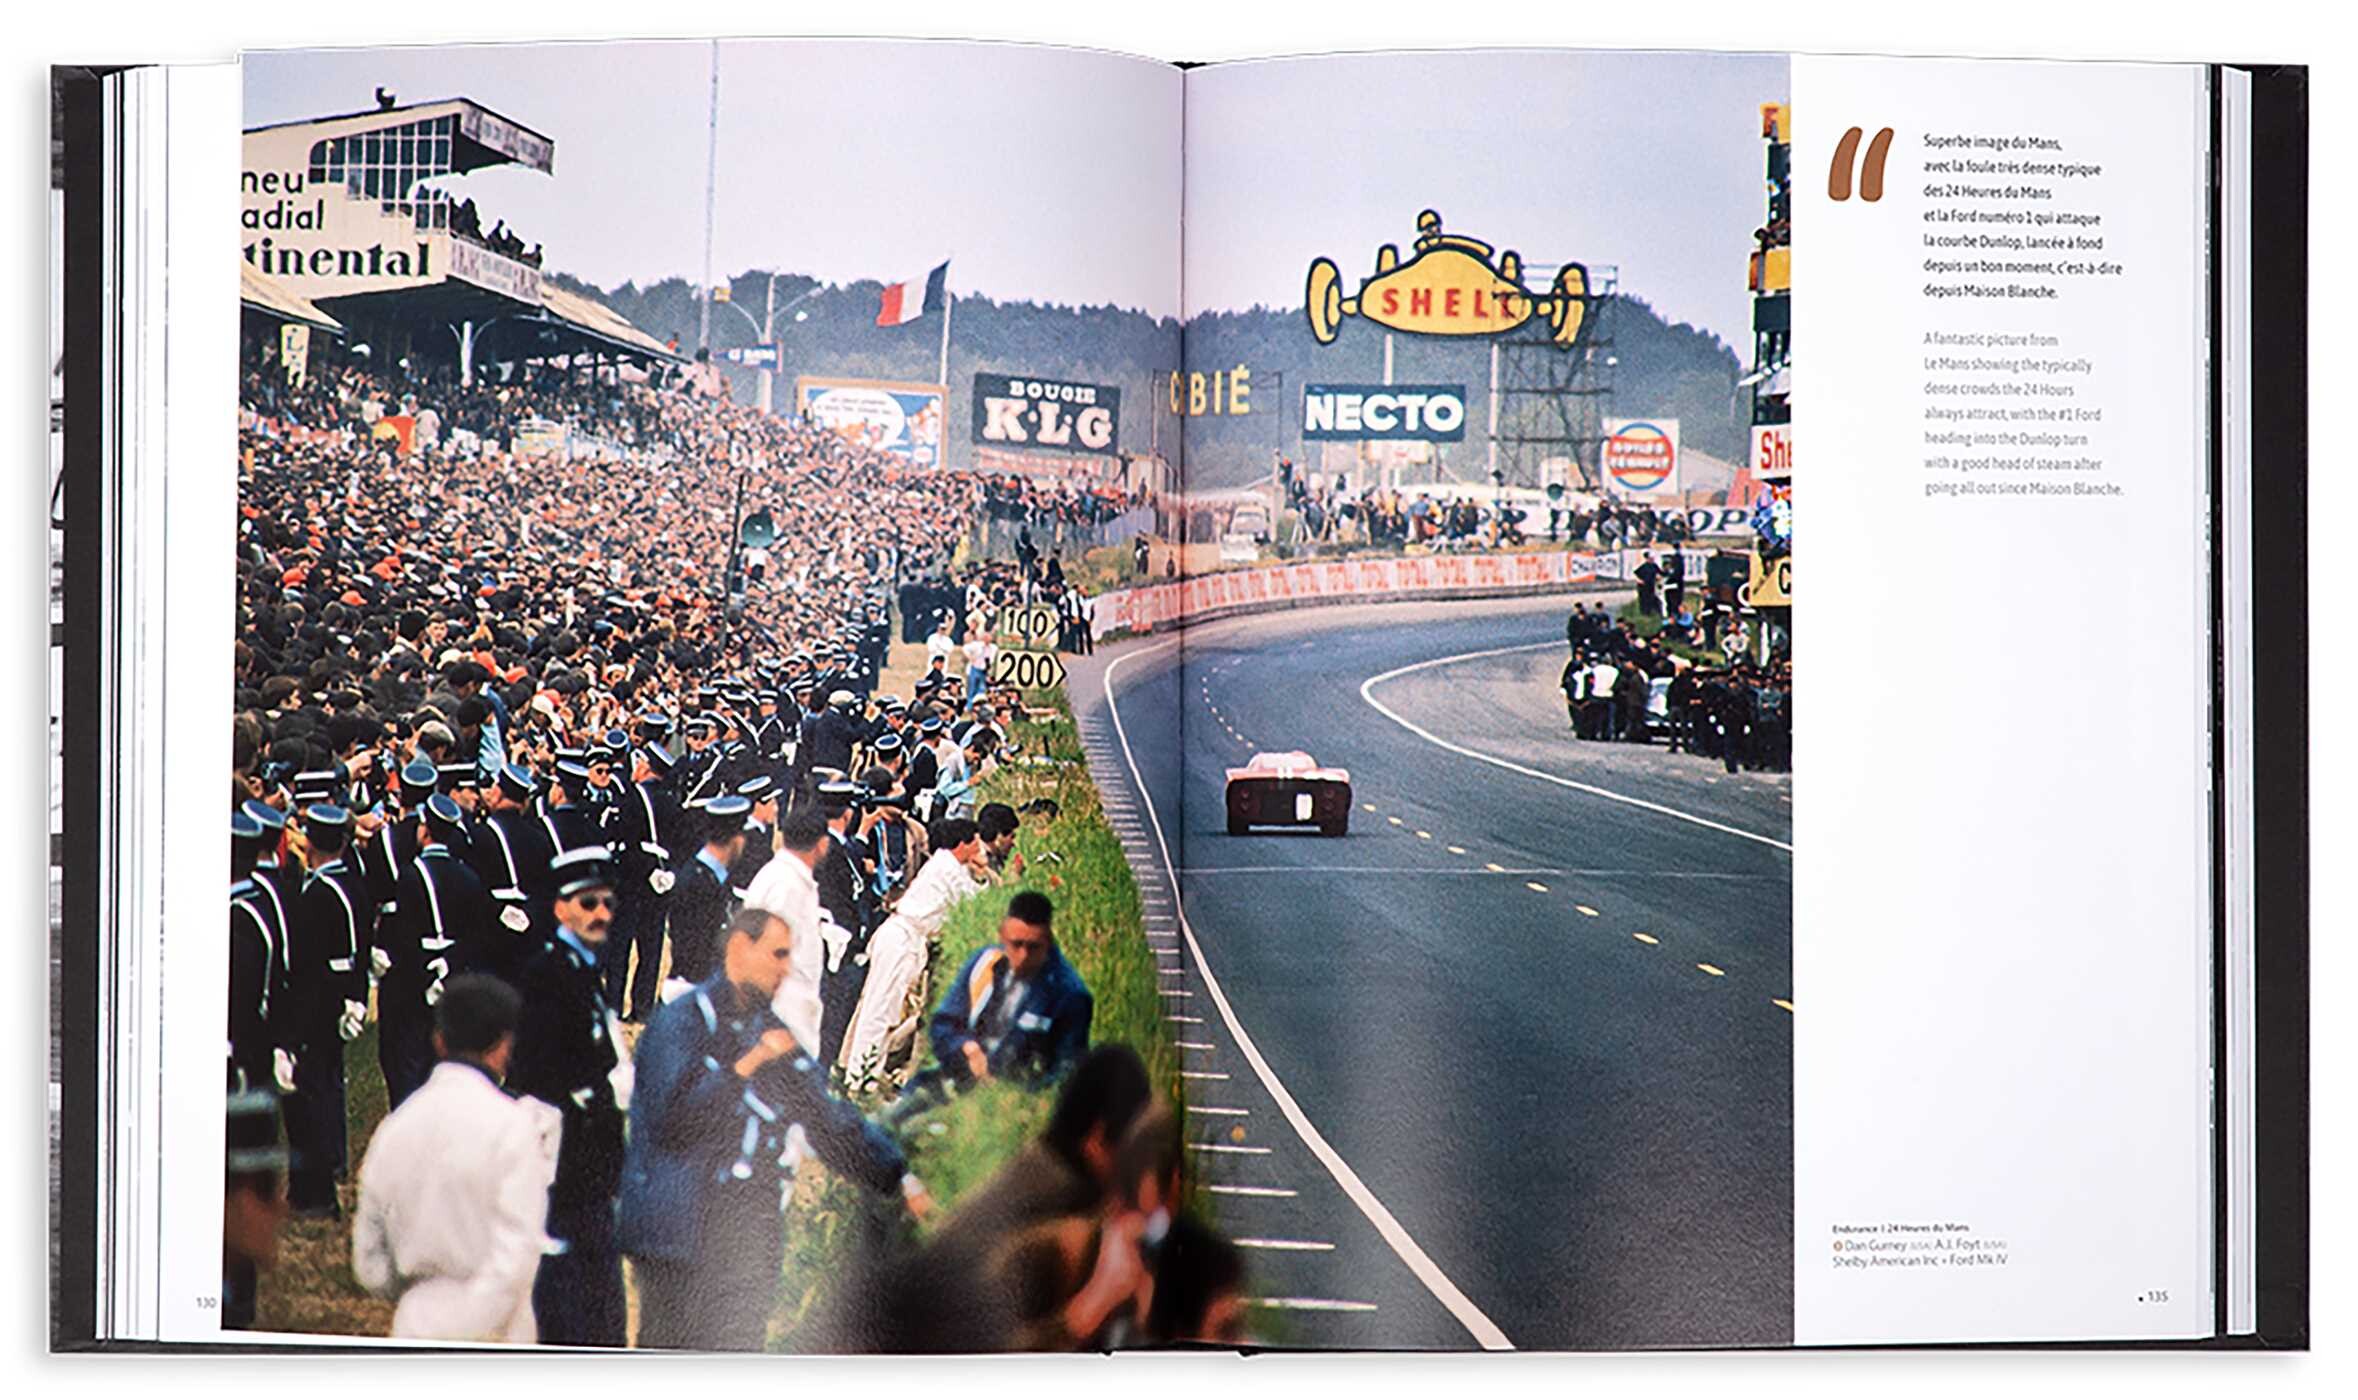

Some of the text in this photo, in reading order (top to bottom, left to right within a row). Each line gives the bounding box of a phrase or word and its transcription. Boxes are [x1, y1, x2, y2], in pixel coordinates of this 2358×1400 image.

[1923, 132, 2062, 152] Superbe image du Mans,
[1923, 159, 2102, 178] avec la foule très dense typique
[240, 171, 304, 194] neu
[1922, 183, 2052, 199] des 24 Heures du Mans
[240, 198, 324, 230] adial
[1923, 208, 2101, 227] et la Ford numéro 1 qui attaque
[1923, 233, 2103, 251] la courbe Dunlop, lancée à fond
[243, 236, 430, 277] tinental
[1922, 258, 1962, 274] depuis
[1963, 261, 1978, 272] un
[1980, 259, 2003, 273] bon
[1922, 283, 2058, 299] depuis Maison Blanche.
[1009, 380, 1096, 405] BOUGIE
[1304, 393, 1465, 432] NECTO
[1006, 609, 1047, 637] 100
[999, 652, 1054, 688] 200
